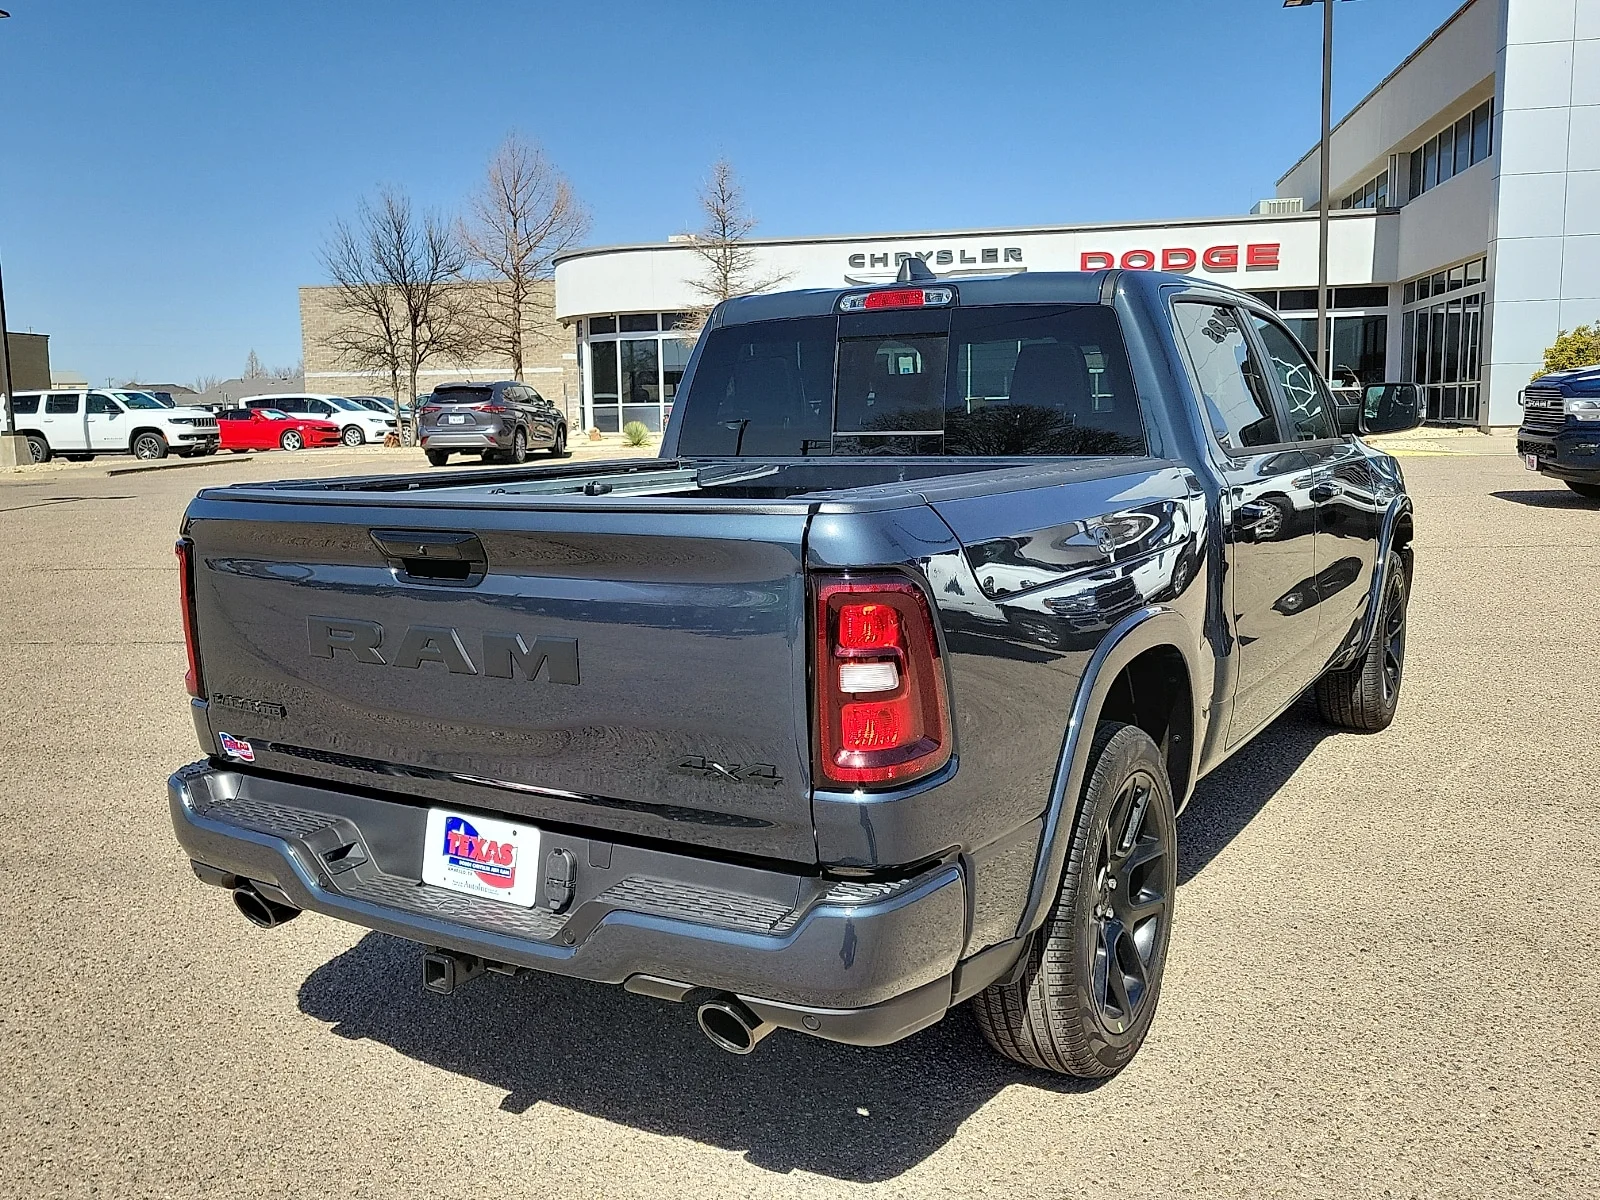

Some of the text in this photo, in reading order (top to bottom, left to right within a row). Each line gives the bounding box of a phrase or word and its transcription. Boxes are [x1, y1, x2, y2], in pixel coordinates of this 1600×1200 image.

[848, 247, 1023, 268] CHRYSLER
[1080, 243, 1281, 273] DODGE
[306, 615, 580, 685] RAM
[447, 830, 513, 866] TEXAS
